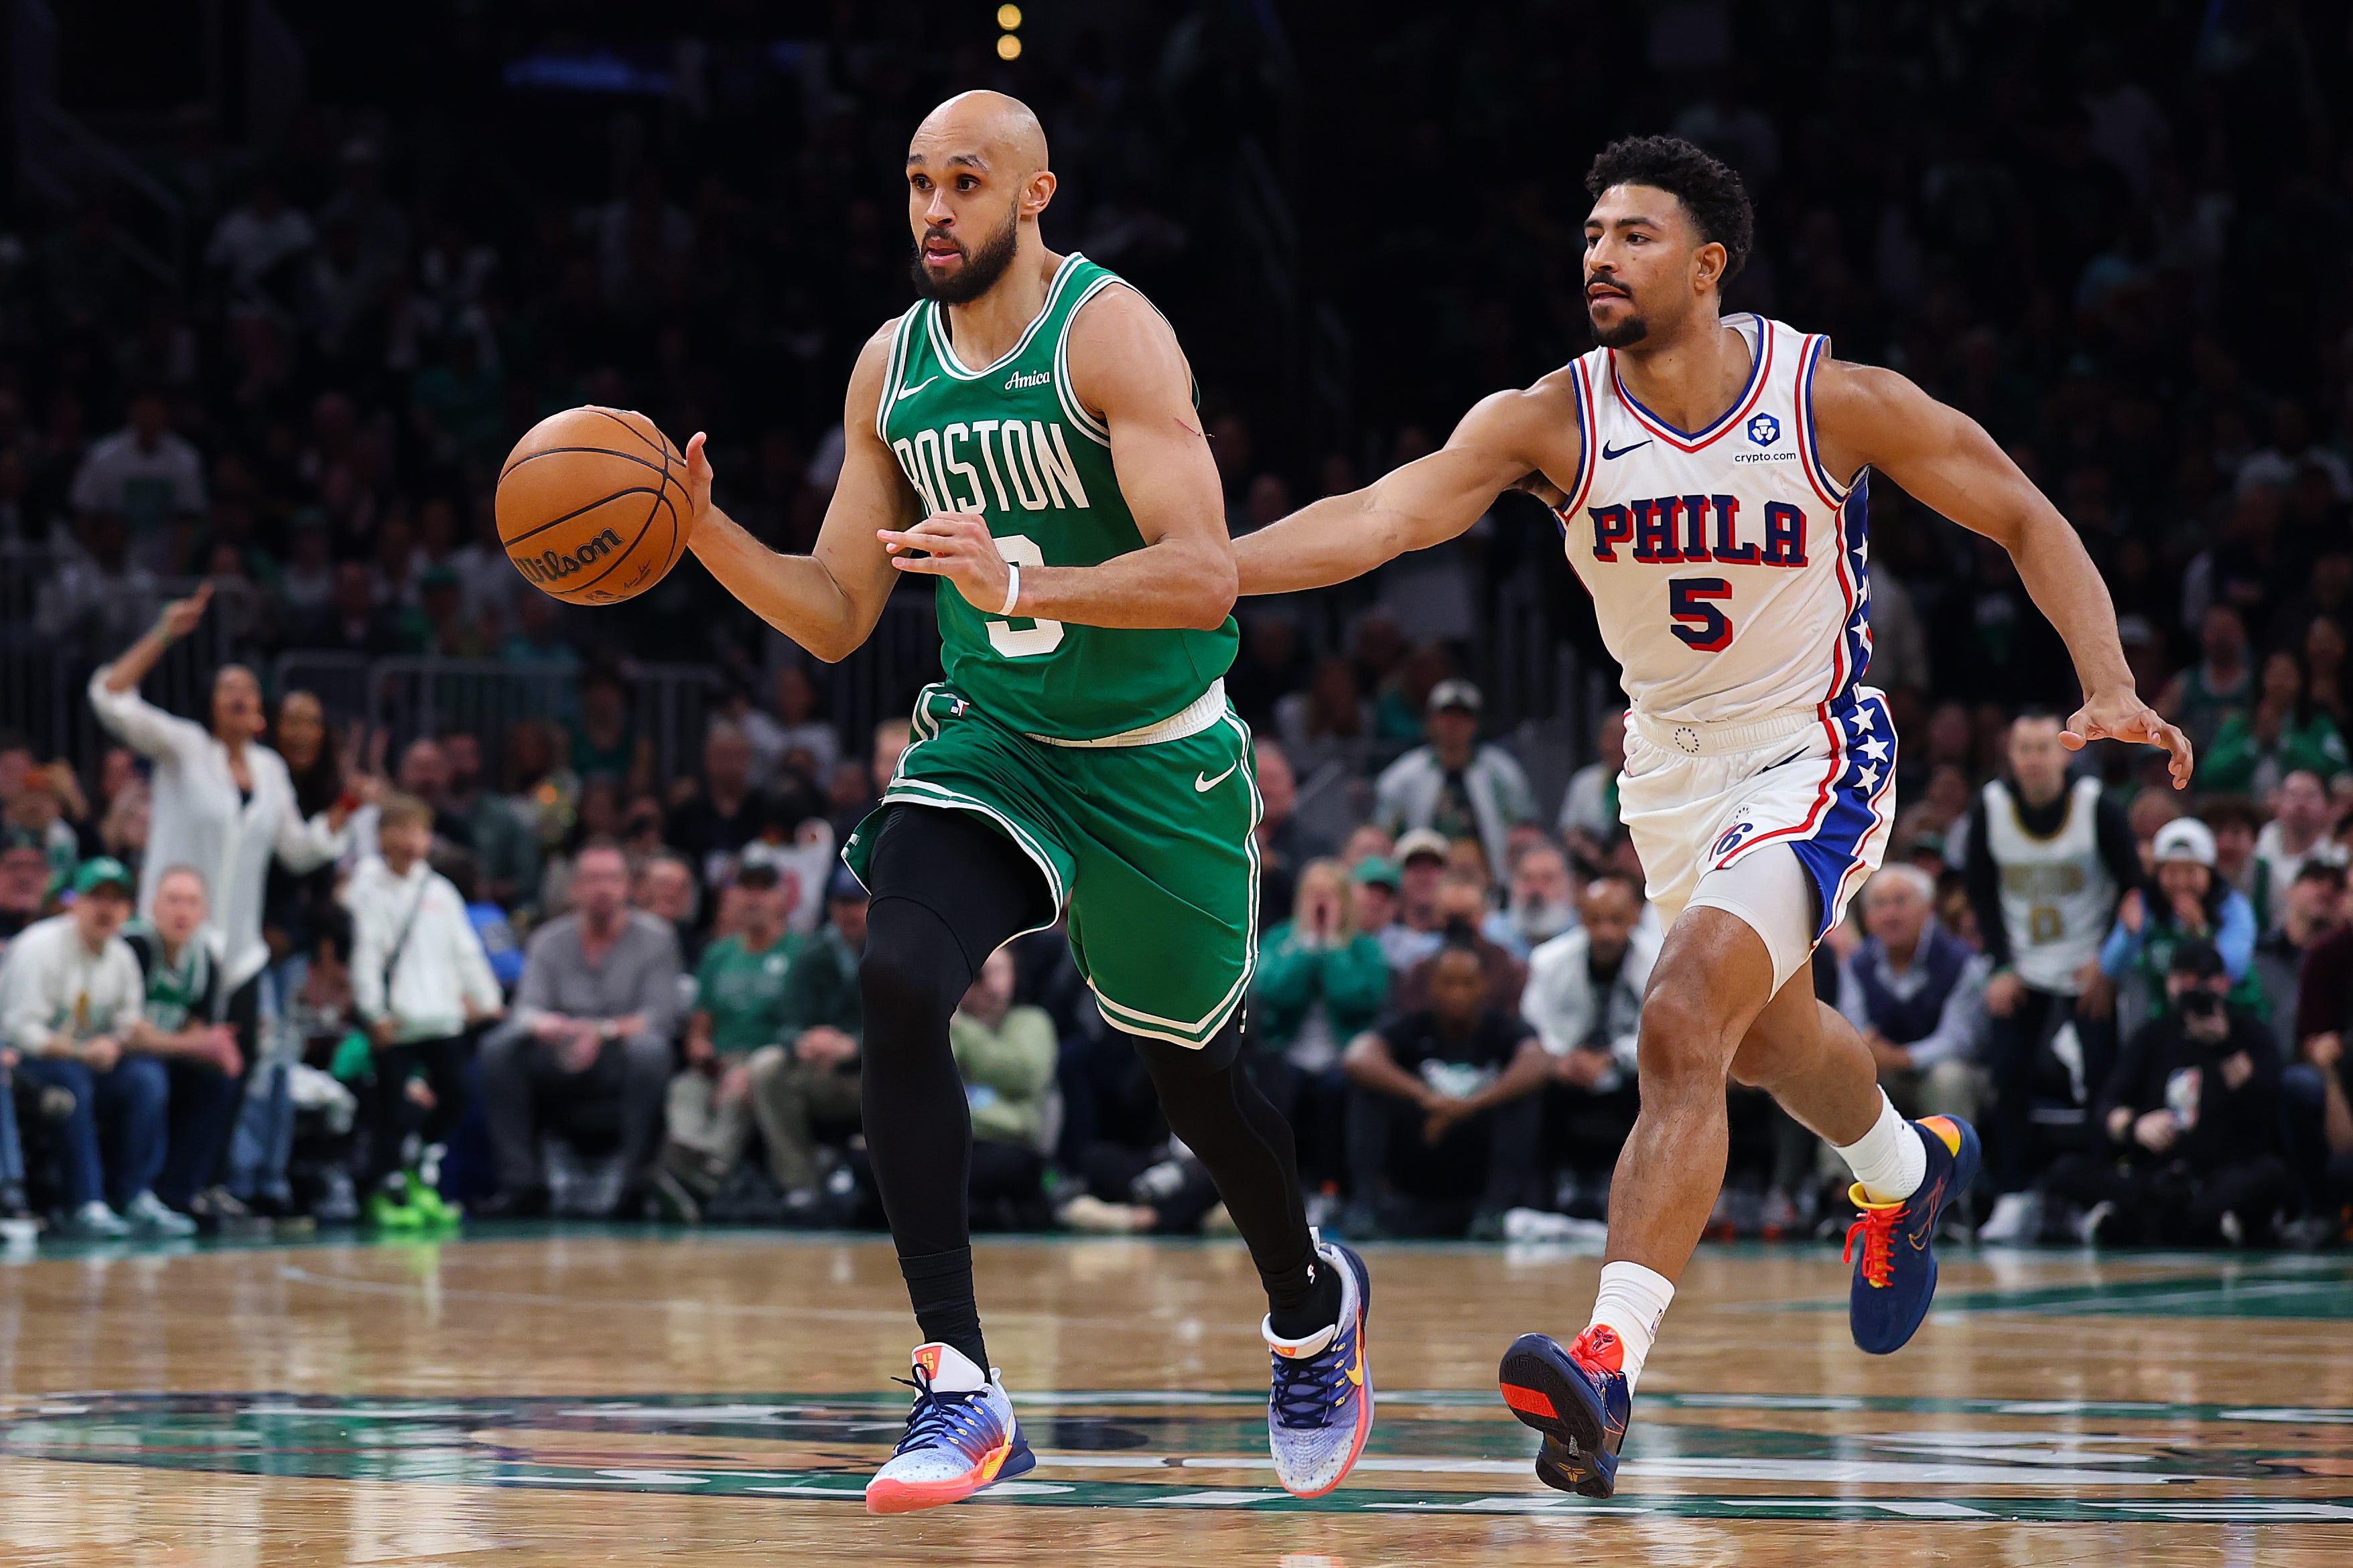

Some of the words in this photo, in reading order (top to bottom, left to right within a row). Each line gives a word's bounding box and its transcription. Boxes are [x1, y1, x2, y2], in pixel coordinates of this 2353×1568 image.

[1004, 369, 1051, 390] Amica
[1735, 452, 1796, 463] crypto.com
[1588, 494, 1808, 567] PHILA
[1668, 577, 1733, 653] 5
